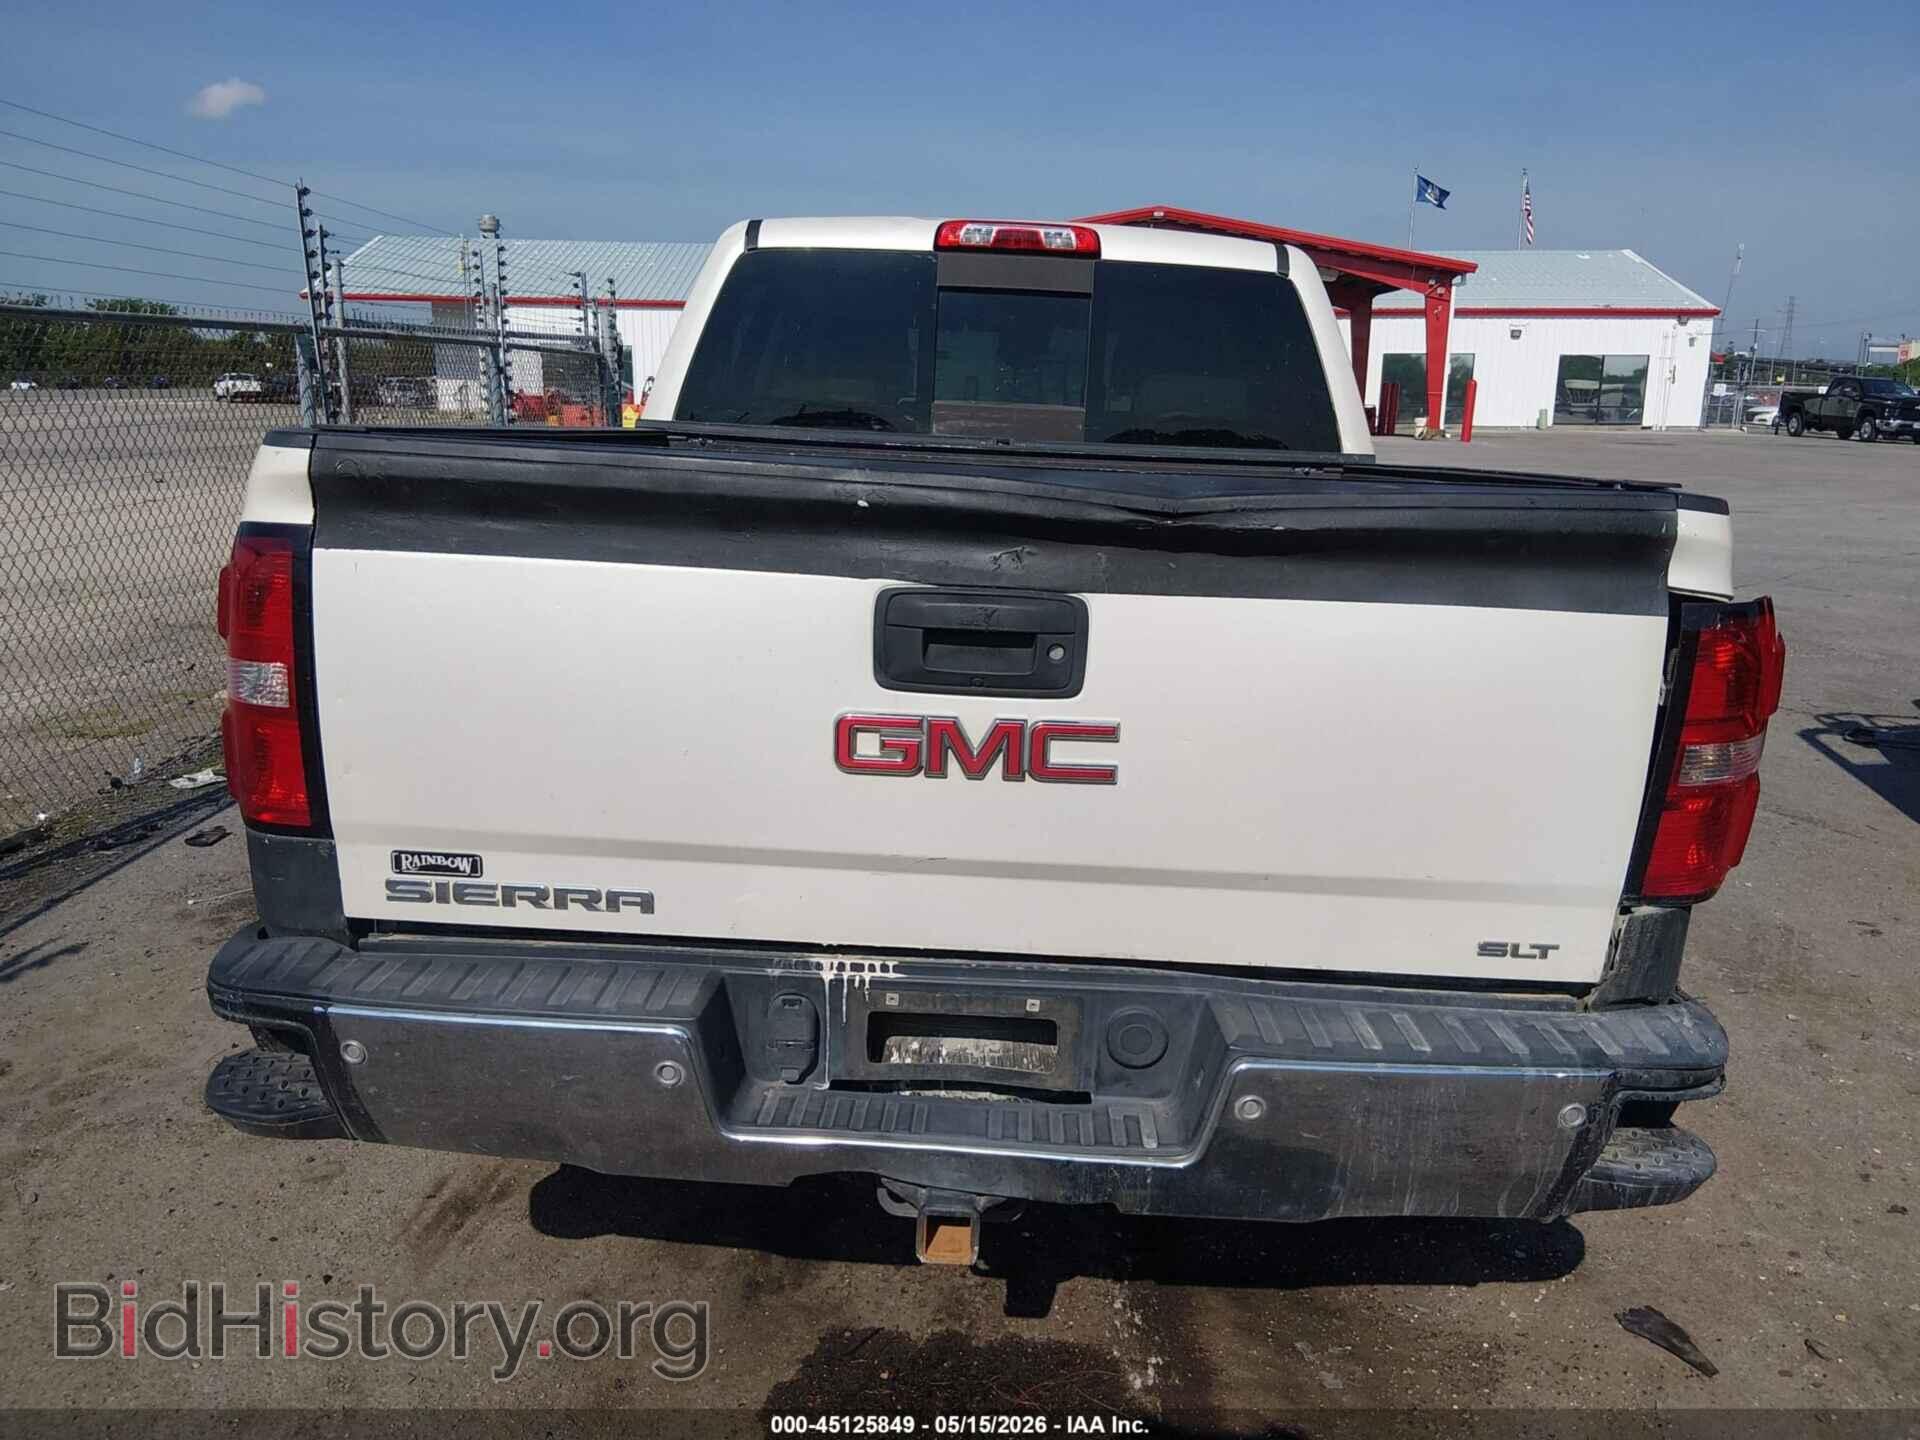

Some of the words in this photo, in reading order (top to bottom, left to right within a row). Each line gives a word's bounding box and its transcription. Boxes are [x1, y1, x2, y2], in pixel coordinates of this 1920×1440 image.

[834, 713, 1120, 785] GMC
[401, 853, 474, 876] RAINBOW
[385, 878, 655, 914] SIERRA
[1477, 942, 1560, 960] SLT
